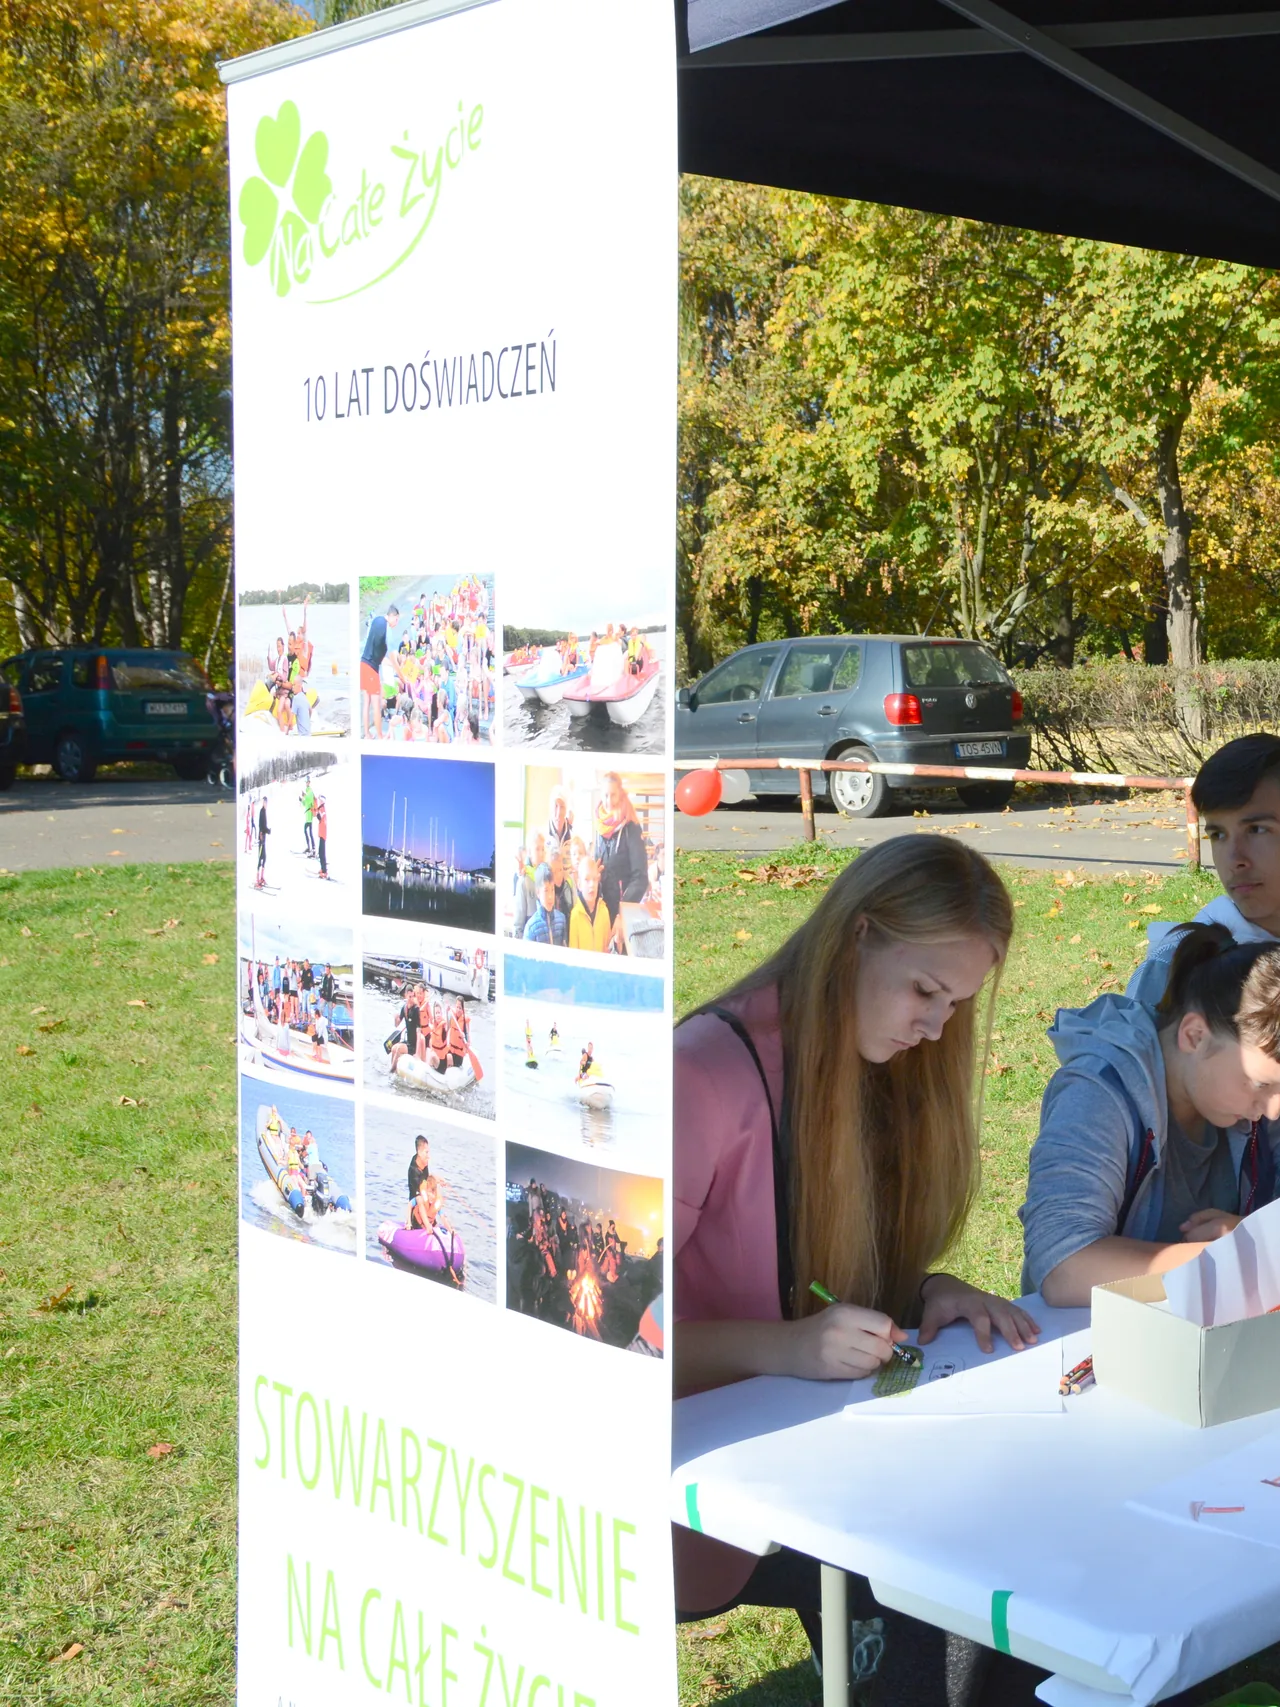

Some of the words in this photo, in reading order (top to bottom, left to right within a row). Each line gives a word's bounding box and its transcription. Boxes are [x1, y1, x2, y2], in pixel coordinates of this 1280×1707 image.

[390, 99, 484, 219] Życie
[303, 375, 327, 422] 10
[334, 367, 375, 419] LAT
[383, 328, 557, 415] DOŚWIADCZEŃ
[960, 743, 979, 755] TOS
[981, 741, 1001, 754] 45VN
[254, 1374, 640, 1636] STOWARZYSZENIE
[286, 1553, 345, 1671] NA
[359, 1587, 459, 1707] CAŁE
